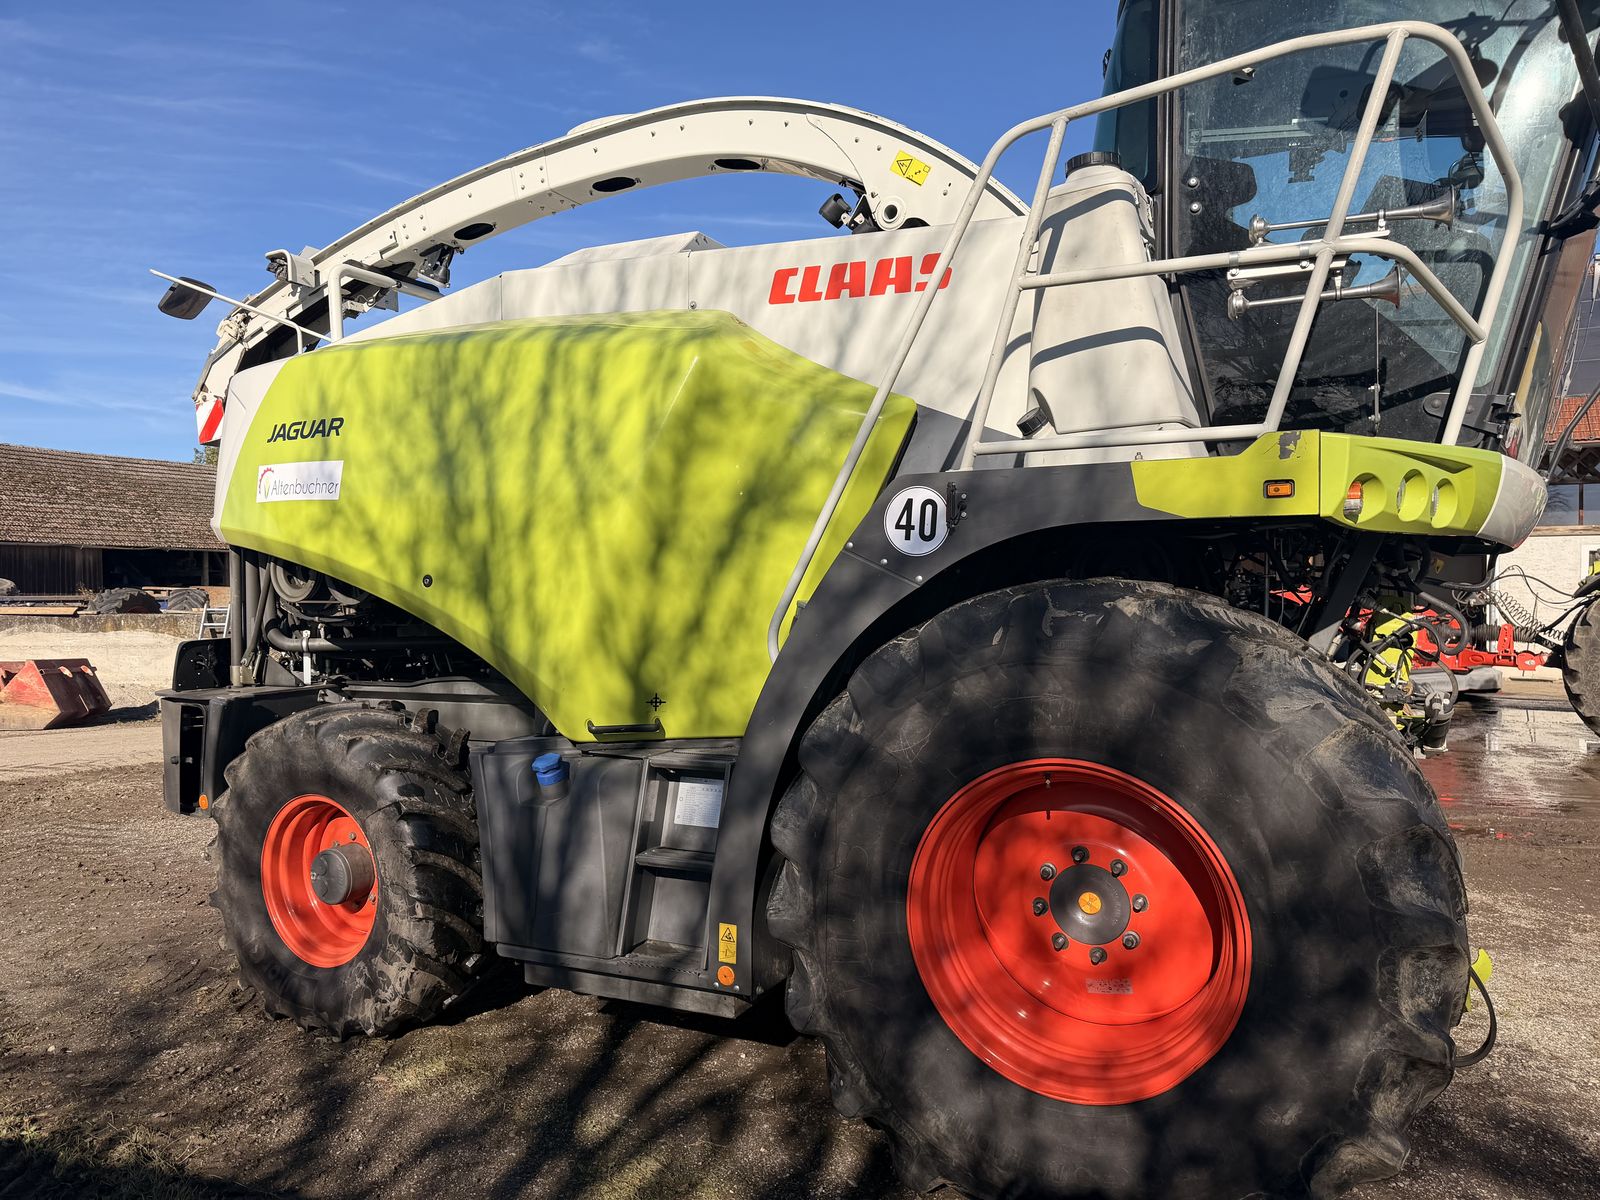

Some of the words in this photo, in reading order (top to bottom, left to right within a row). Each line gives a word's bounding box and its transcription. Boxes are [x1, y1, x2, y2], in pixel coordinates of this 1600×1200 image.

[769, 253, 953, 304] CLAAS
[266, 417, 344, 443] JAGUAR
[271, 478, 339, 496] Altenbuchner
[895, 498, 938, 542] 40
